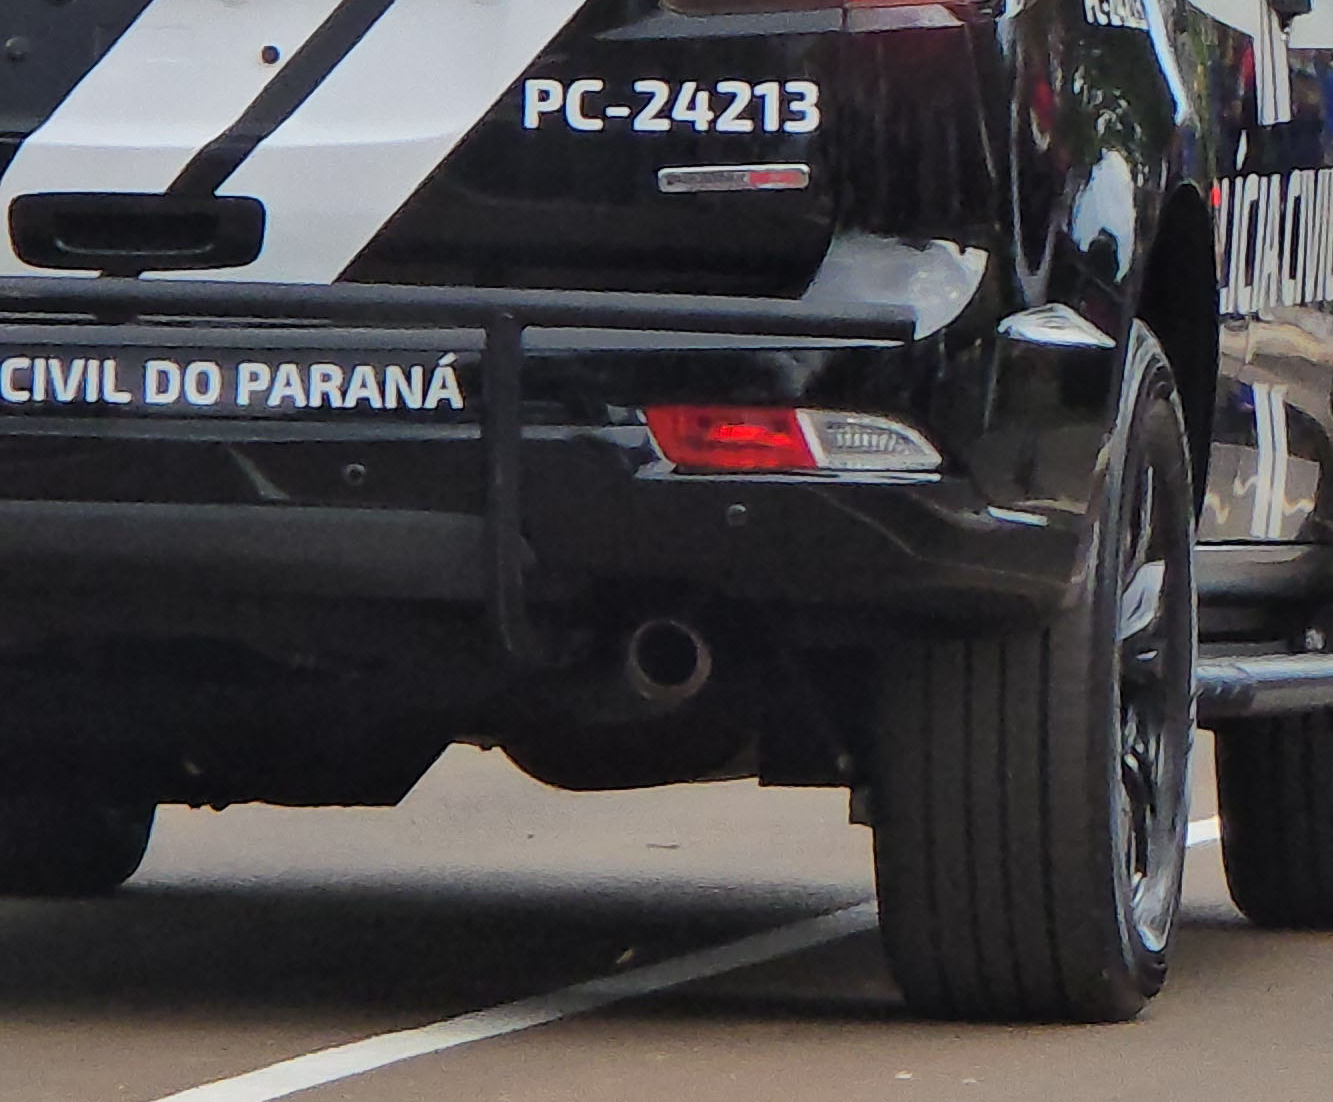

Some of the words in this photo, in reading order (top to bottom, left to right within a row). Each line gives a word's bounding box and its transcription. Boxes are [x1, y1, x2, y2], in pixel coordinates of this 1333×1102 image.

[523, 79, 820, 133] PC-24213
[1217, 130, 1281, 315] LÍCIA
[1, 357, 133, 403] CIVIL
[144, 359, 222, 405] DO
[236, 352, 465, 409] PARANÁ
